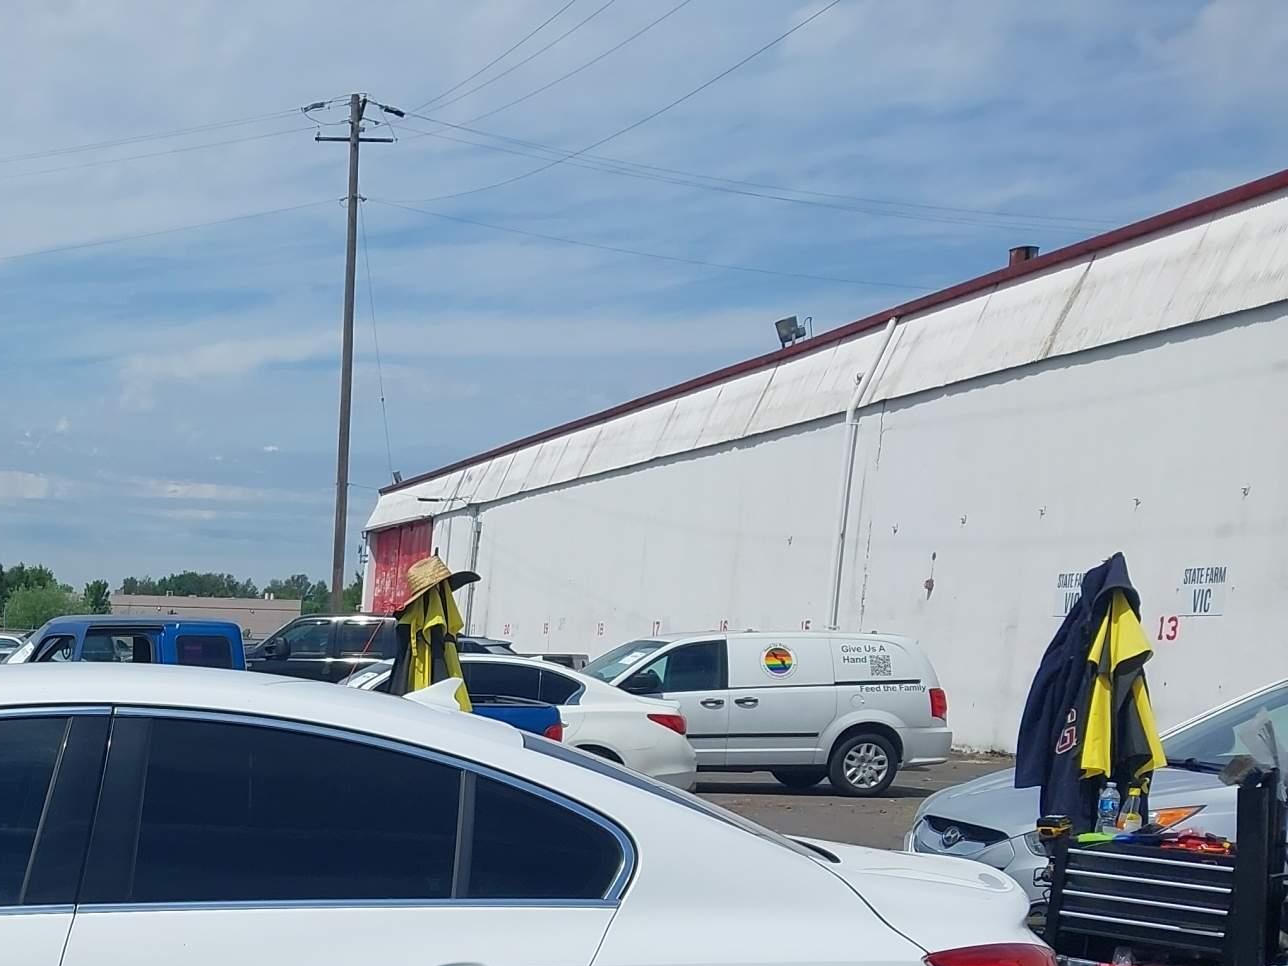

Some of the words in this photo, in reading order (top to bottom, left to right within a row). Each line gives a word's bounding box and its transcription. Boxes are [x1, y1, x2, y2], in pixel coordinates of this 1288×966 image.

[1057, 573, 1074, 588] STATE
[1074, 572, 1088, 588] FA
[1184, 567, 1204, 585] STATE
[1205, 566, 1227, 584] FARM
[1192, 588, 1211, 613] VIC
[652, 621, 661, 637] 17
[1158, 616, 1179, 641] 13
[841, 644, 862, 653] Give
[864, 645, 877, 653] Us
[842, 656, 867, 664] Hand
[860, 685, 882, 693] Feed
[883, 684, 897, 692] the
[899, 683, 926, 693] Family
